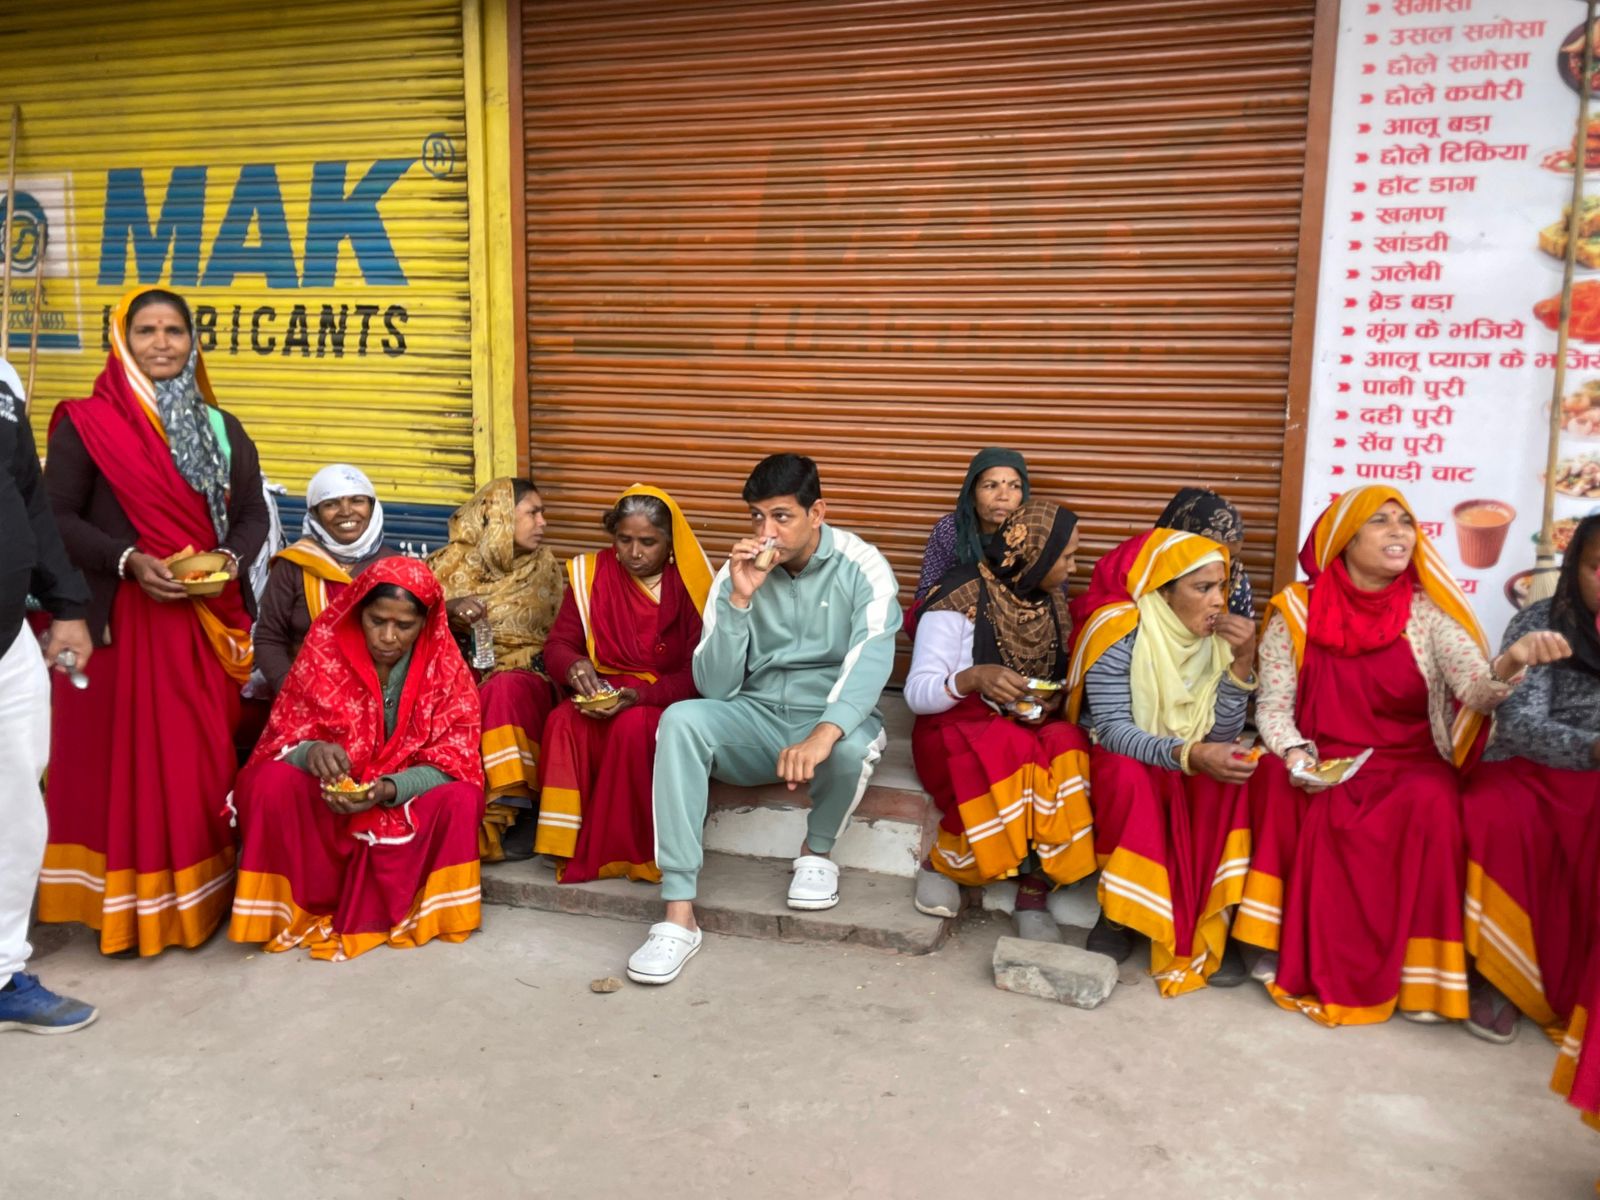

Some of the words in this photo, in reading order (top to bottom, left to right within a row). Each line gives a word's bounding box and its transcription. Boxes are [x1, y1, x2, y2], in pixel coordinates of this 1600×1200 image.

[1462, 18, 1547, 42] समोसा
[1386, 52, 1439, 76] छोले
[1449, 49, 1530, 73] समोसा
[1384, 82, 1437, 106] छोले
[1383, 115, 1441, 139] आलू
[1379, 143, 1432, 166] छोले
[1439, 139, 1528, 164] टिकिया
[97, 159, 418, 288] MAK
[1376, 206, 1446, 224] खमण
[1371, 259, 1443, 283] जलेबी
[1367, 289, 1404, 313] ब्रेड
[1413, 318, 1440, 339] के
[1448, 317, 1526, 340] भजिये
[1364, 351, 1421, 373] आलू
[1427, 351, 1492, 368] प्याज
[1498, 348, 1527, 369] के
[1362, 375, 1415, 397] पानी
[1423, 376, 1466, 401] पुरी
[1360, 403, 1403, 427] दही
[1412, 404, 1454, 429] पुरी
[1403, 432, 1445, 458] पुरी
[1431, 465, 1475, 483] चाट
